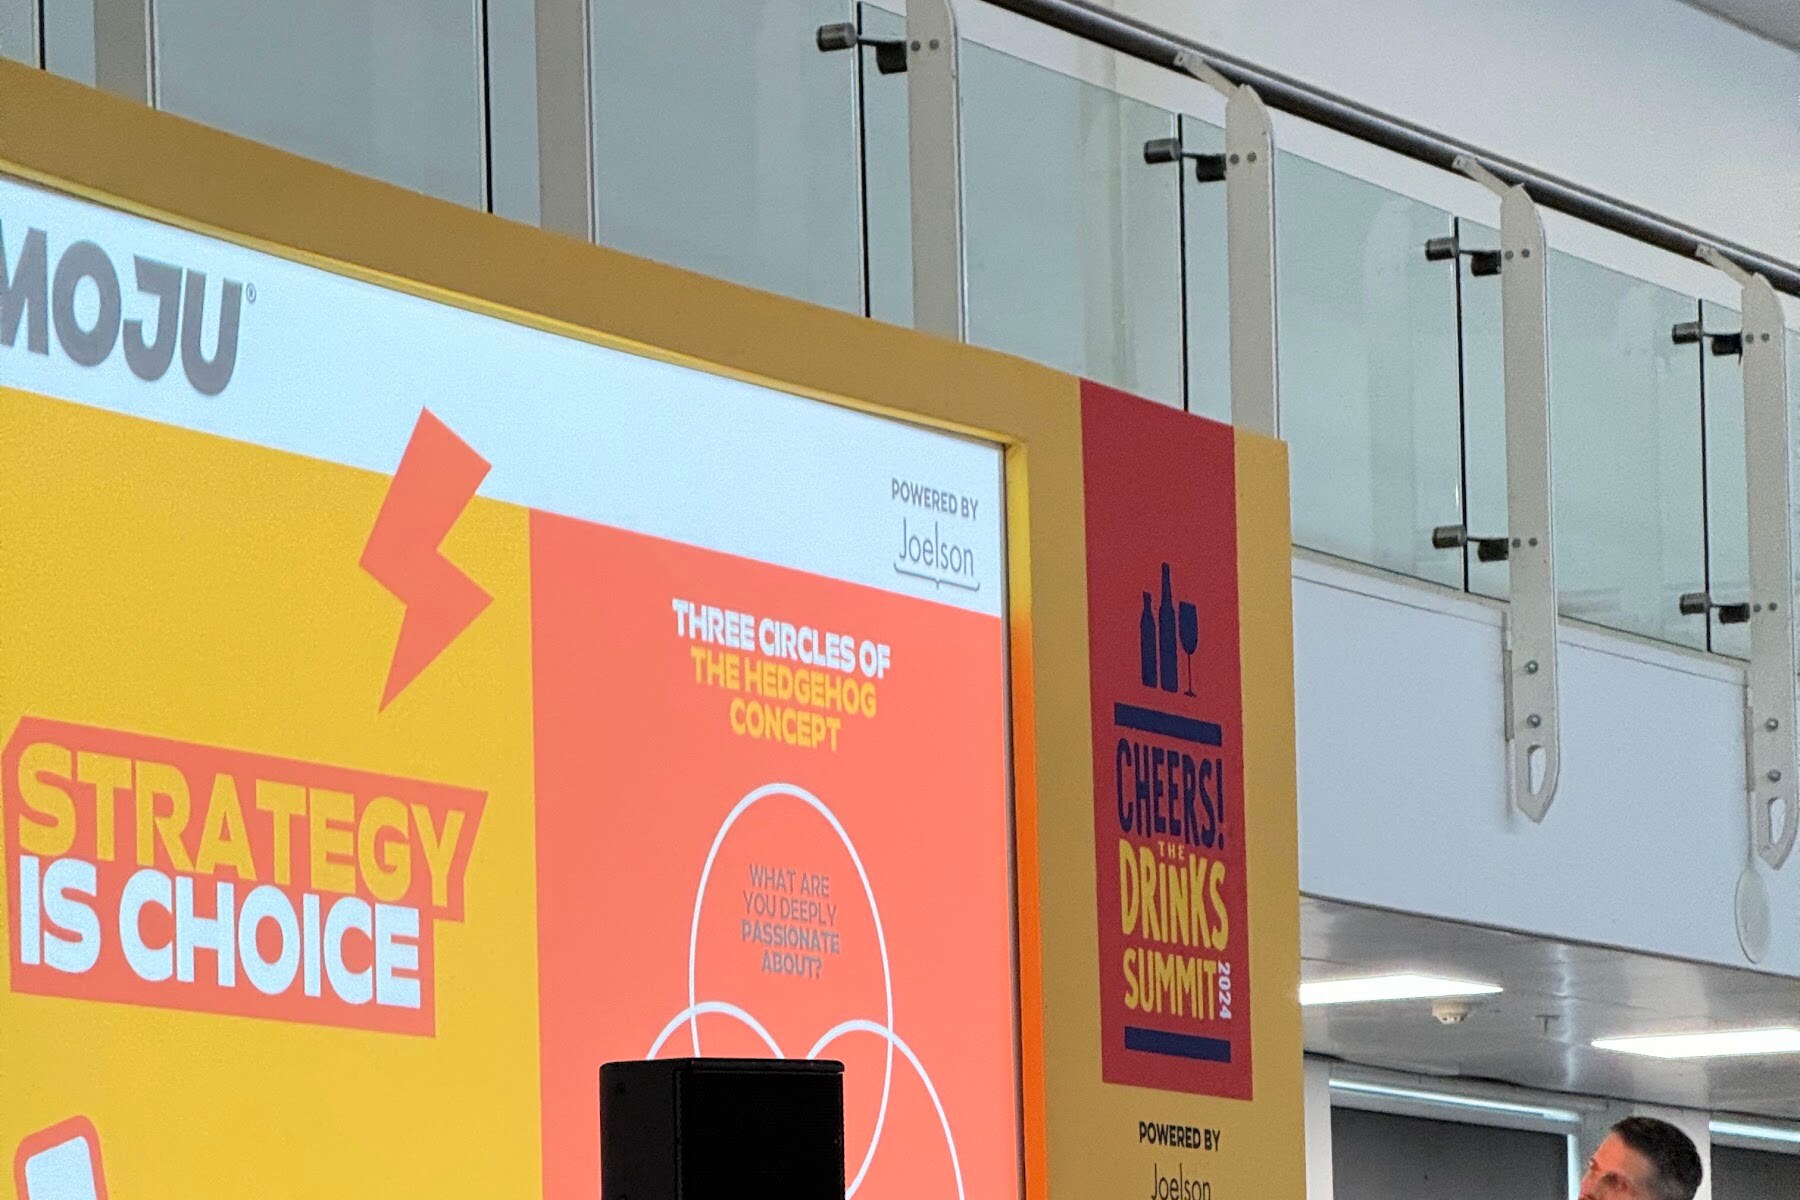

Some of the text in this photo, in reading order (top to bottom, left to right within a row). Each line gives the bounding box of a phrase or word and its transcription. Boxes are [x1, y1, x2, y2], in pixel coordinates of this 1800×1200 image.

[892, 478, 978, 519] POWERED BY
[899, 517, 974, 576] Joelson
[672, 598, 890, 679] THREE CIRCLES OF
[691, 646, 877, 719] THE HEDGEHOG
[730, 697, 841, 752] CONCEPT
[1116, 738, 1224, 850] CHEERS!
[18, 742, 466, 908] STRATEGY
[1157, 840, 1185, 861] THE
[743, 890, 837, 927] YOU DEEPLY
[749, 864, 829, 898] WHAT ARE
[1119, 838, 1229, 951] DRINKS
[19, 856, 421, 1009] IS CHOICE
[741, 918, 840, 953] PASSIONATE
[761, 949, 822, 979] ABOUT?
[1123, 948, 1217, 1020] SUMMIT
[1217, 960, 1232, 1019] 2024
[1139, 1121, 1220, 1151] POWERED BY
